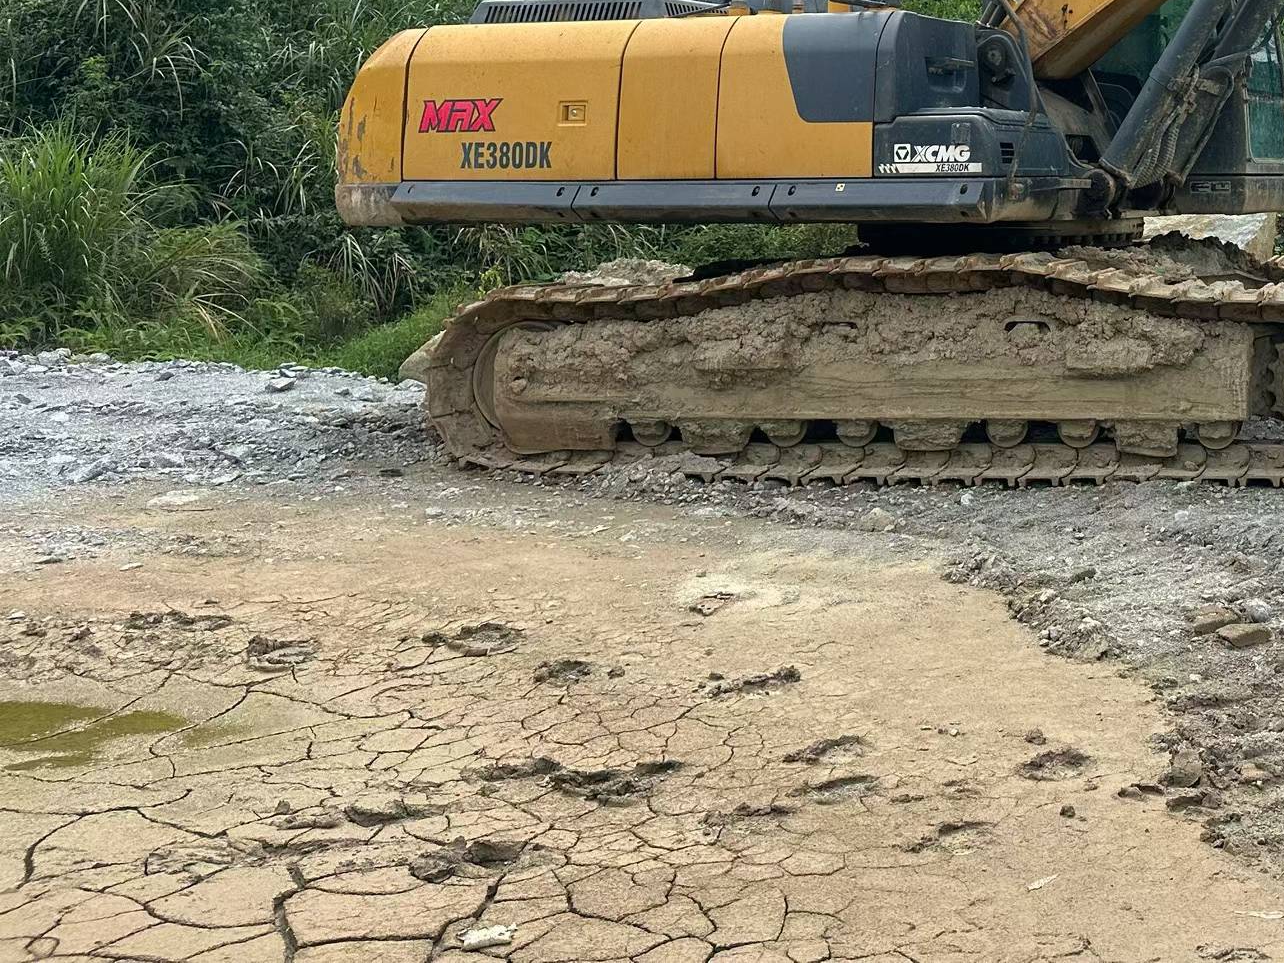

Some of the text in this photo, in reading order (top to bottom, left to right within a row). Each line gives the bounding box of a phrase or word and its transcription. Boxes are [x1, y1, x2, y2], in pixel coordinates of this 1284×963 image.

[418, 98, 503, 133] MAX
[460, 141, 553, 169] XE380DK
[911, 145, 971, 162] XCMG
[935, 163, 970, 172] XE380DK
